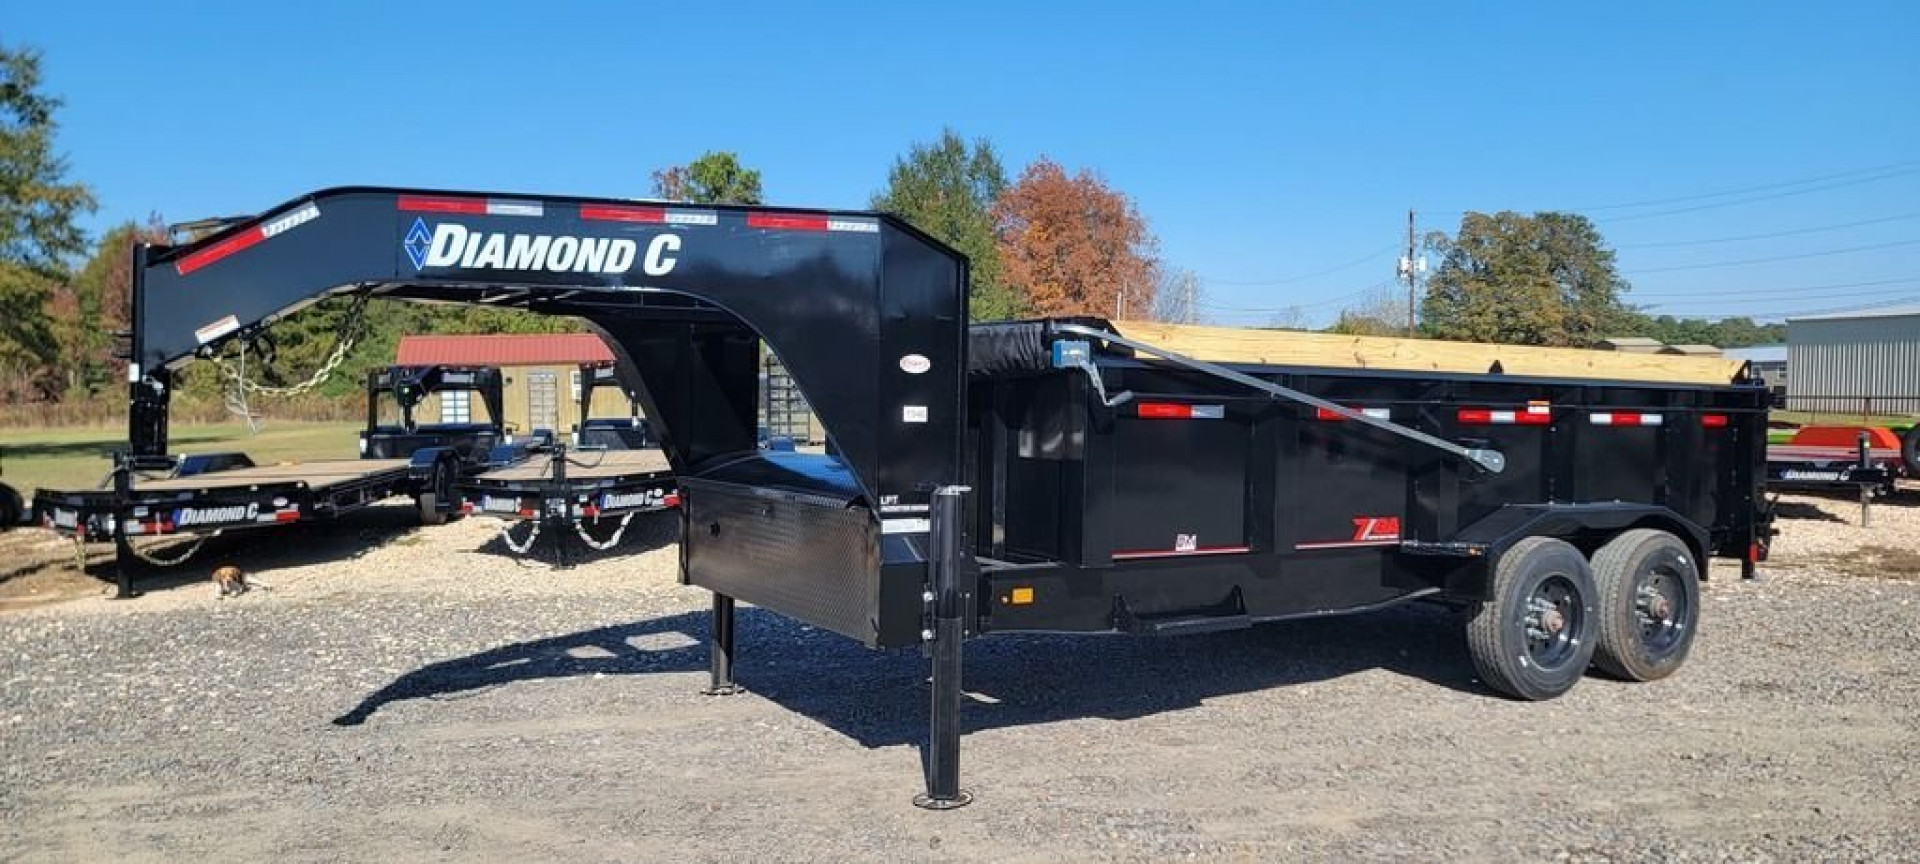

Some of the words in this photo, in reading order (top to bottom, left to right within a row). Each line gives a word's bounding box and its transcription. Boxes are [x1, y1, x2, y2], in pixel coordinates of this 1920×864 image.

[426, 223, 636, 273] DIAMOND
[644, 234, 681, 276] C
[180, 505, 245, 526] DIAMOND
[247, 502, 259, 519] C
